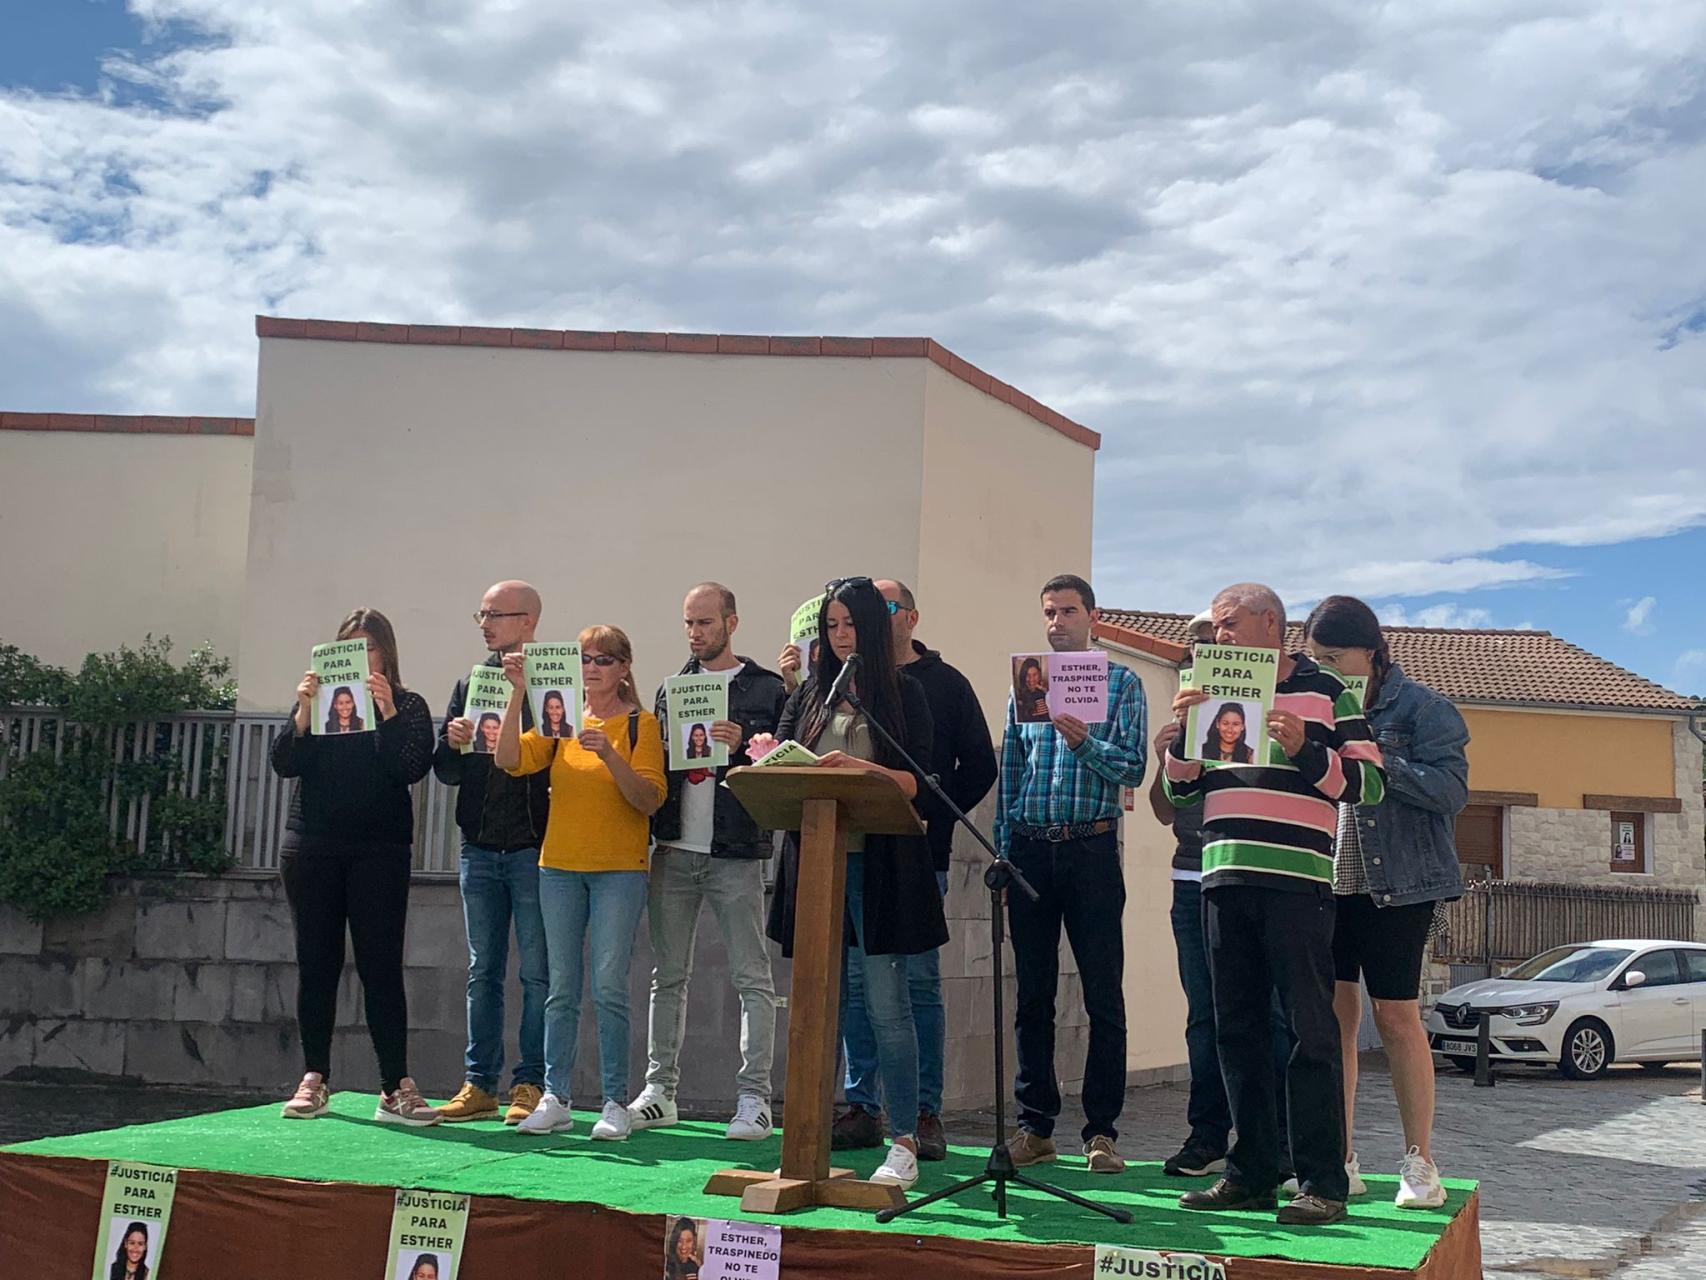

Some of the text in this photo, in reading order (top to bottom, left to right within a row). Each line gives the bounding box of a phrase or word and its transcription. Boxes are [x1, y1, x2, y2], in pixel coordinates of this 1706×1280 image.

[1195, 648, 1275, 664] #JUSTICIA
[323, 658, 352, 669] PARA
[535, 662, 565, 671] PARA
[317, 671, 360, 685] ESTHER
[1212, 667, 1252, 680] PARA
[530, 676, 573, 686] ESTHER
[477, 684, 504, 695] PARA
[671, 684, 722, 694] #JUSTICIA
[1201, 684, 1261, 698] ESTHER
[683, 696, 709, 706] PARA
[678, 708, 715, 718] ESTHER
[110, 1166, 174, 1184] #JUSTICIA
[124, 1186, 155, 1200] PARA
[397, 1194, 466, 1211] #JUSTICIA
[113, 1203, 162, 1218] ESTHER
[411, 1216, 447, 1229] PARA
[400, 1234, 453, 1249] ESTHER
[721, 1233, 767, 1246] ESTHER,
[708, 1246, 778, 1261] TRASPINEDO
[725, 1262, 758, 1273] NO TE
[1100, 1256, 1224, 1280] #JUSTICIA
